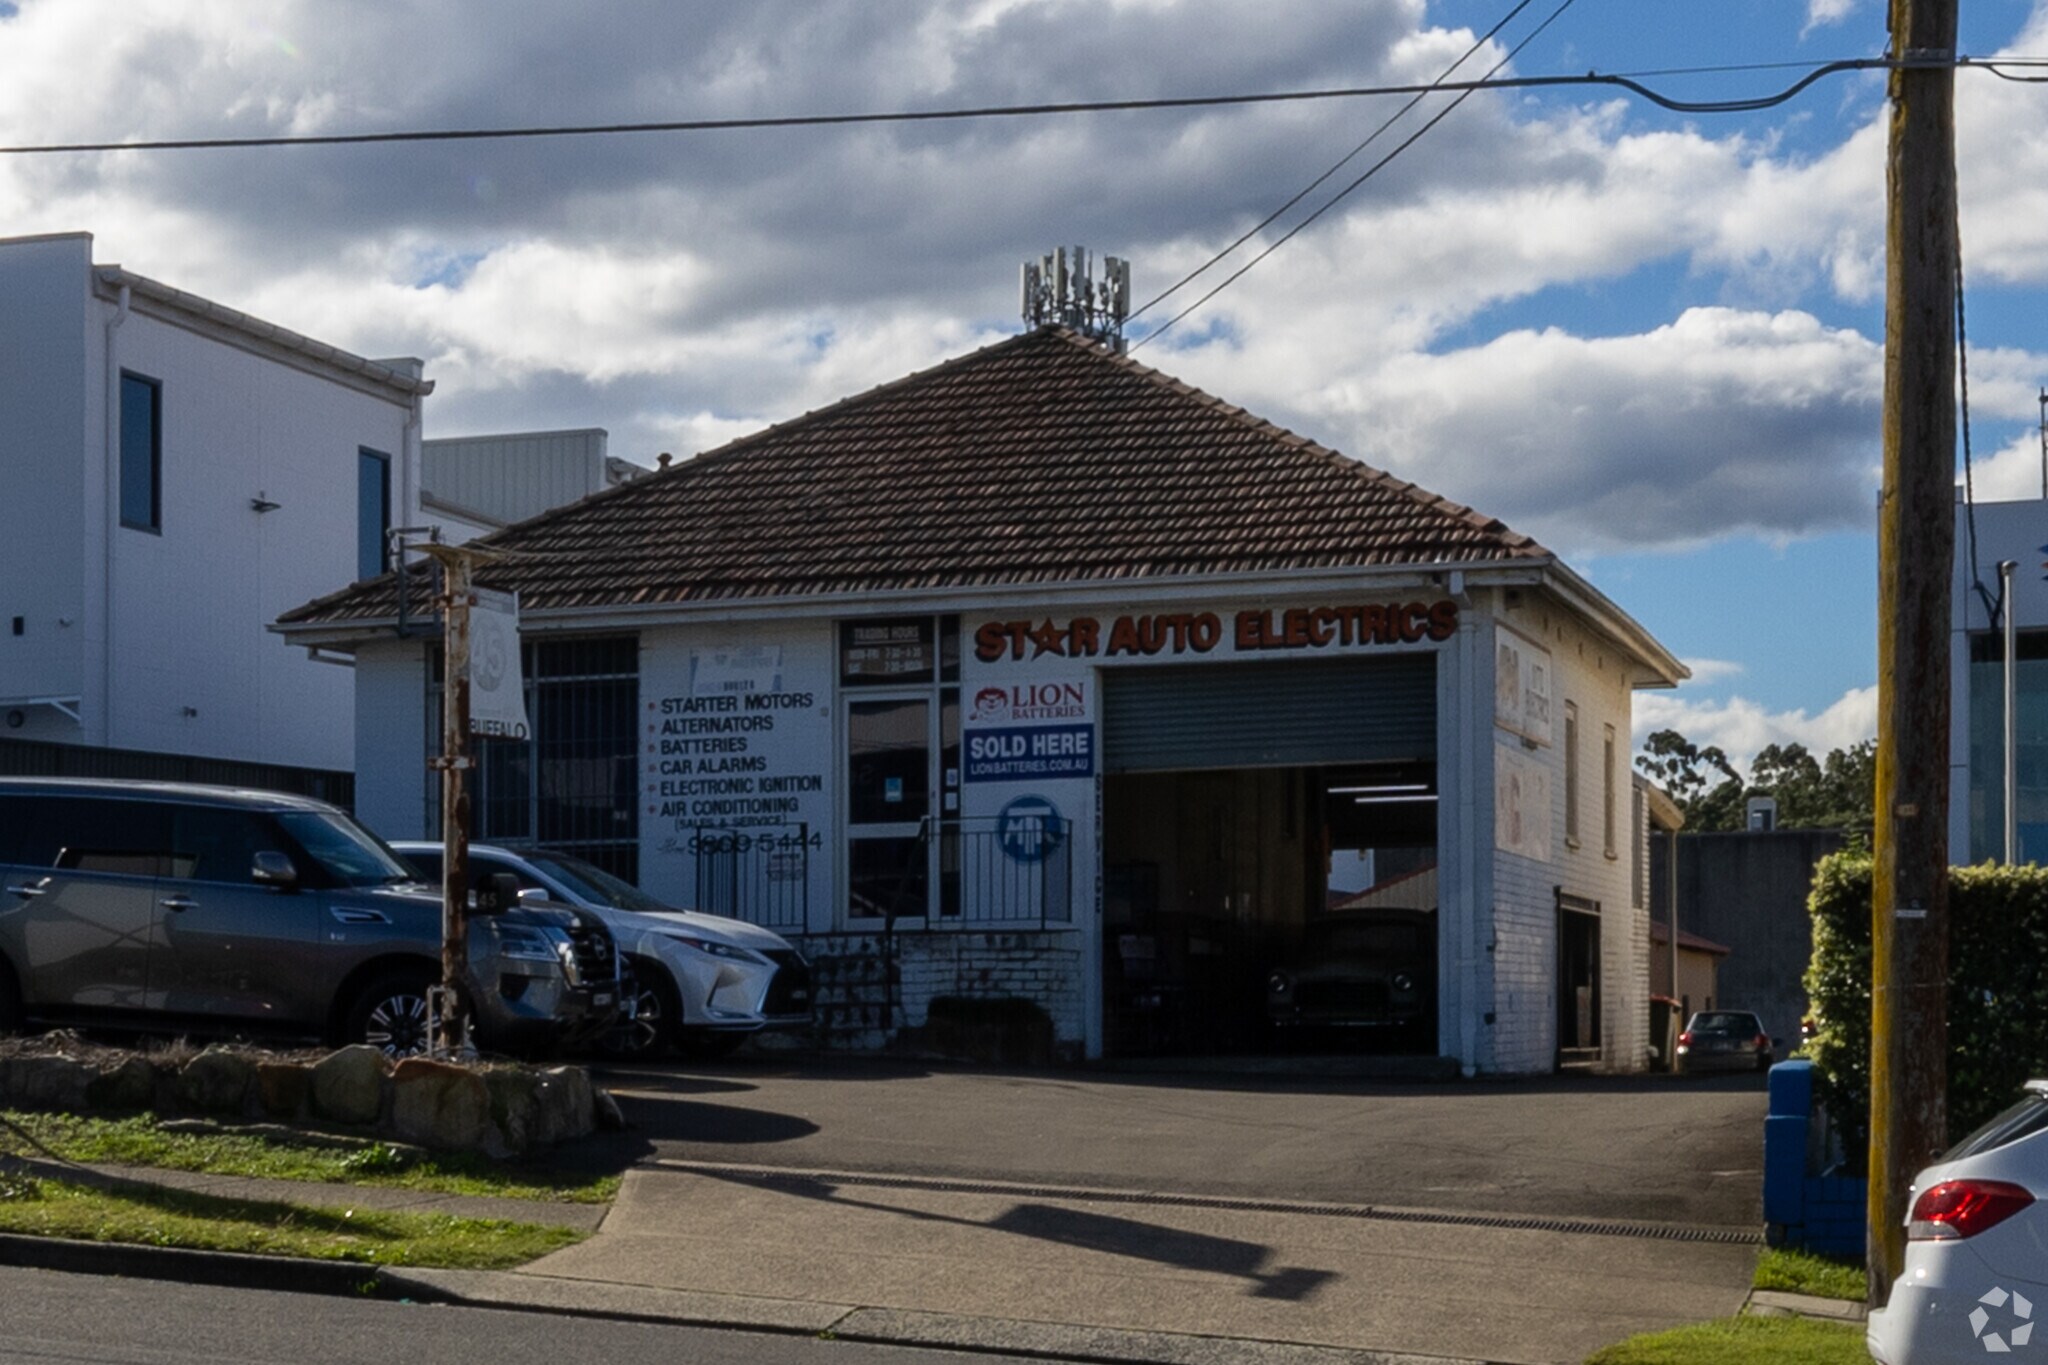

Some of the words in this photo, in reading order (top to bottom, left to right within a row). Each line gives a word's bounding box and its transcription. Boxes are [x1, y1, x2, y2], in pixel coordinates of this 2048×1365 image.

[1106, 611, 1222, 657] AUTO
[1234, 600, 1458, 651] ELECTRICS
[661, 695, 737, 715] STARTER
[744, 692, 813, 711] MOTORS
[1012, 682, 1085, 708] LION
[1011, 705, 1085, 721] BATTERIES
[661, 715, 774, 735] ALTERNATORS
[661, 737, 748, 755] BATTERIES
[970, 735, 1027, 760] SOLD
[1032, 732, 1089, 757] HERE
[660, 759, 693, 776] CAR
[697, 756, 767, 774] ALARMS
[970, 758, 1089, 775] LIONBATTERIES.COM.AU
[661, 778, 754, 797] ELECTRONIC
[759, 775, 822, 793] IGNITION
[661, 802, 687, 817] AIR
[692, 797, 799, 815] CONDITIONING
